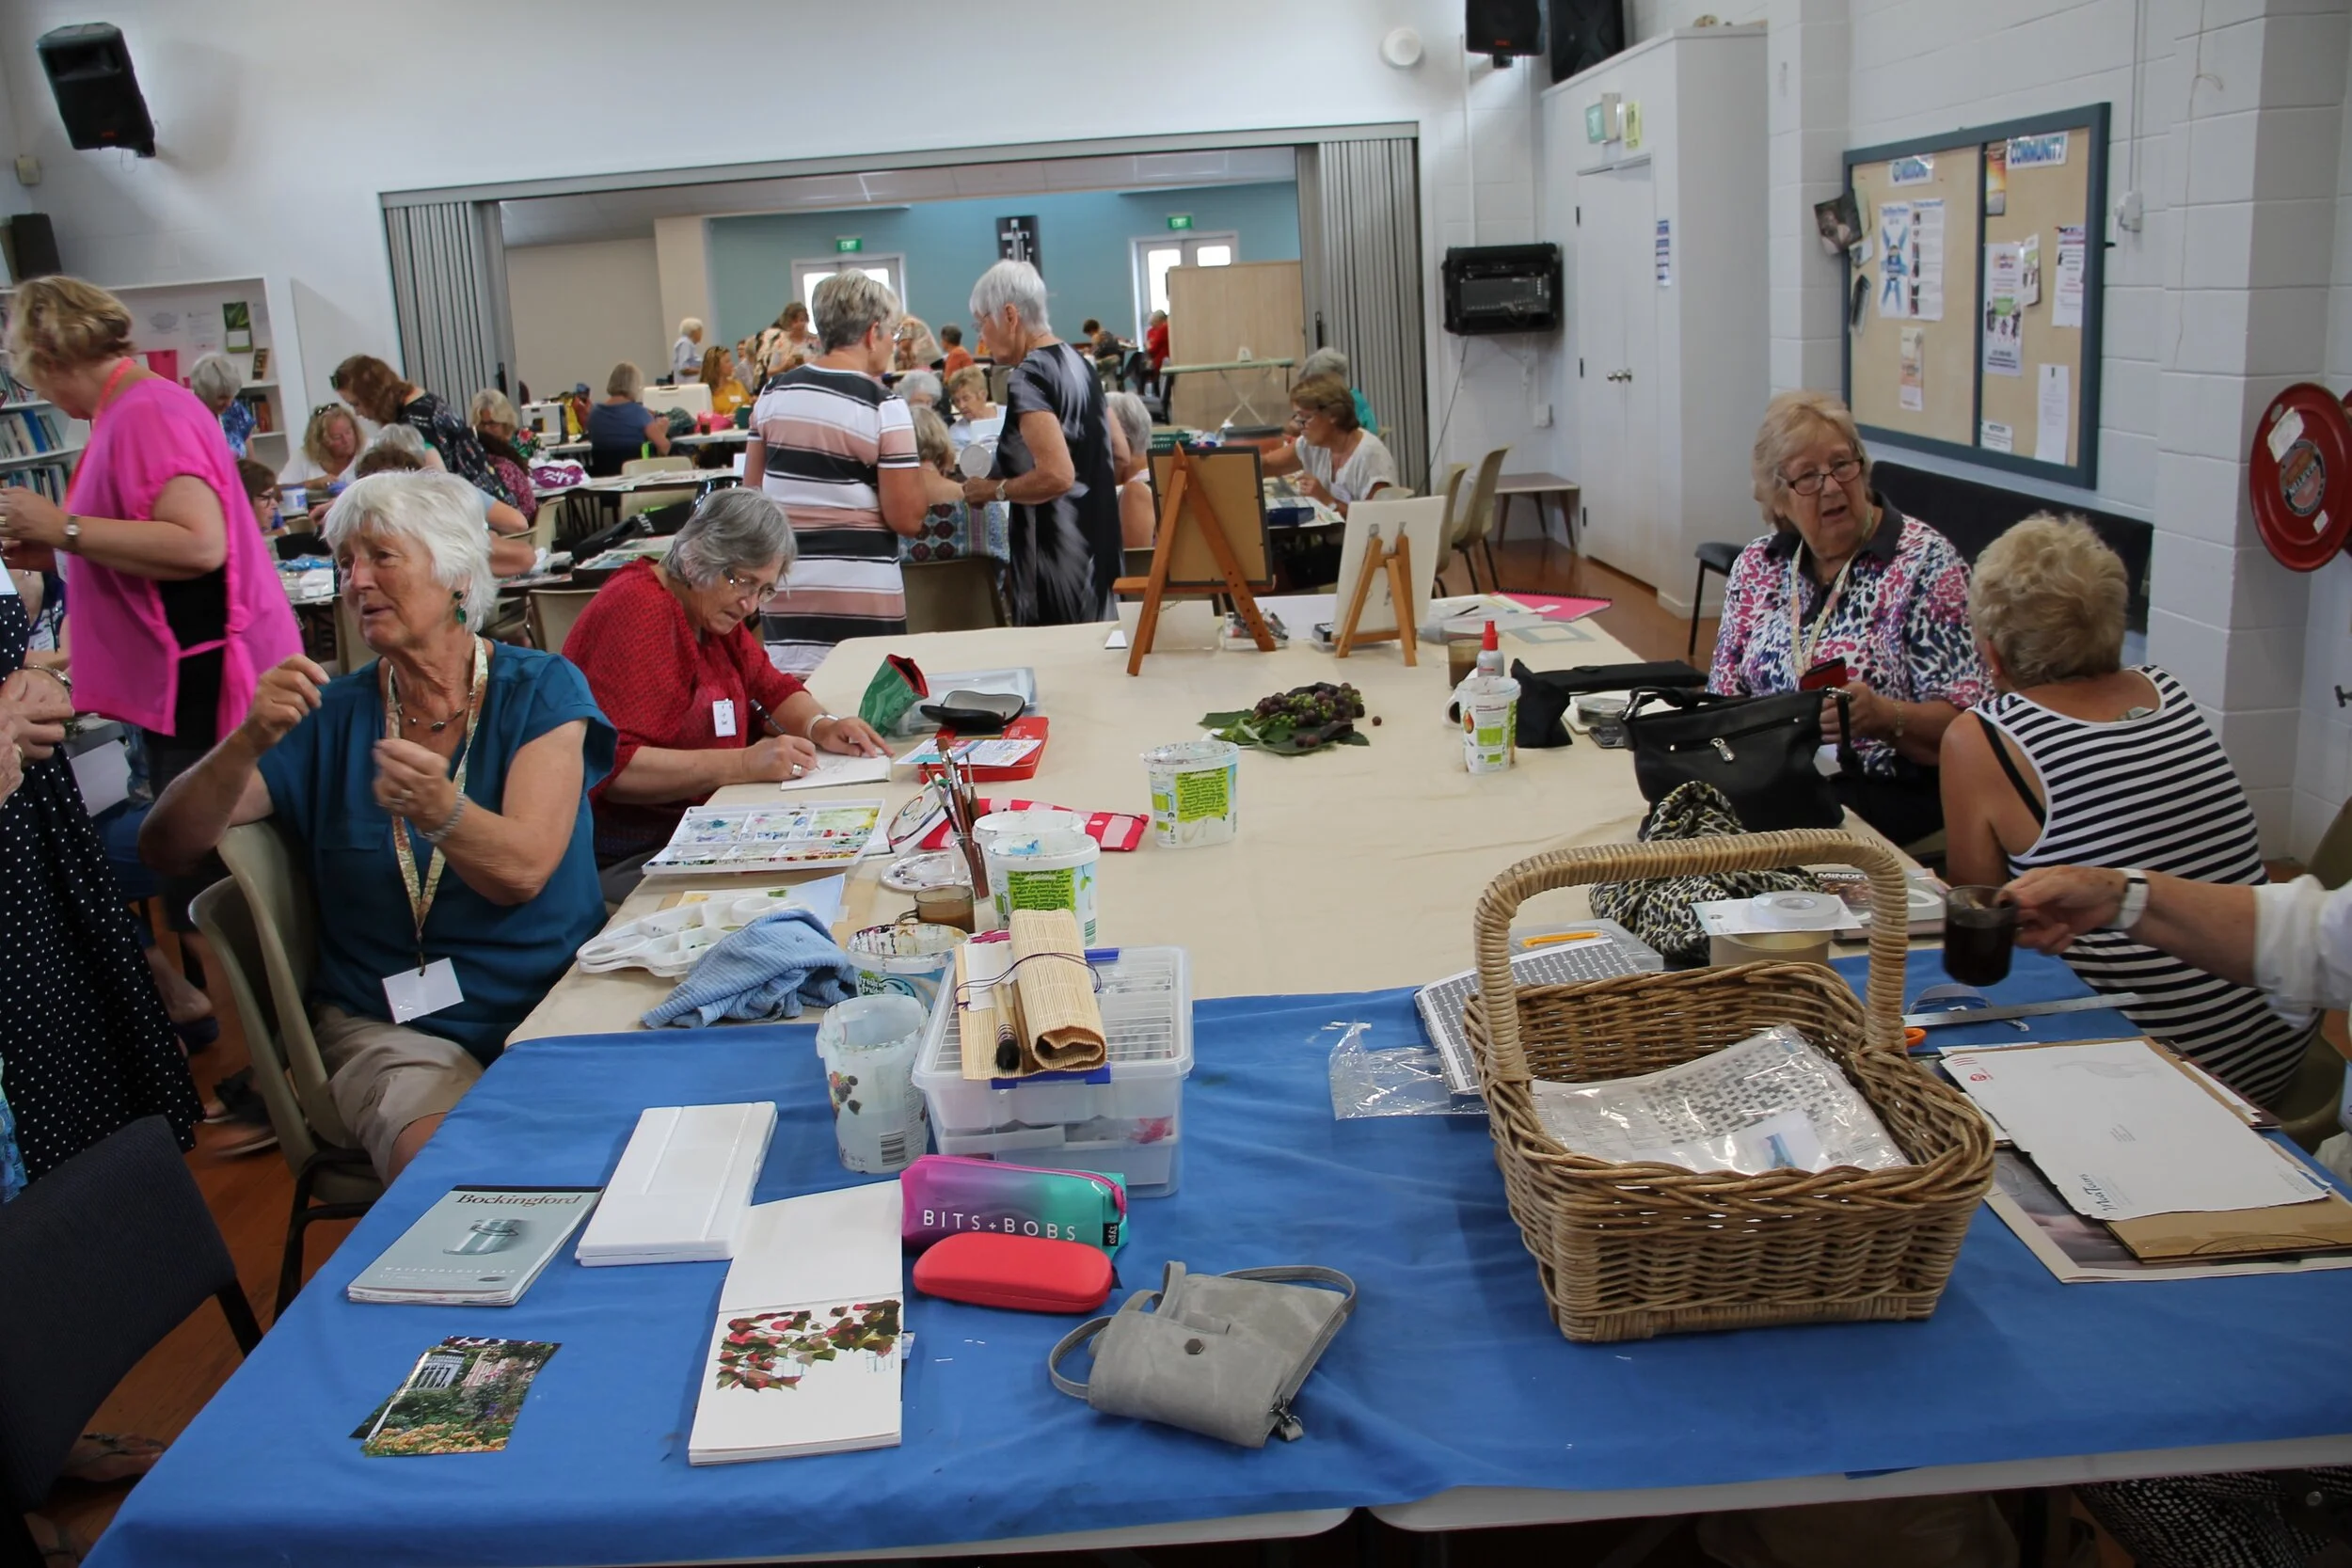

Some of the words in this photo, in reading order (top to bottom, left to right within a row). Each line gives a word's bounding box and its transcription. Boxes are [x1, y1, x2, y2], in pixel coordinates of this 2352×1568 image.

[2010, 135, 2065, 165] COMMUNITY
[456, 1194, 582, 1208] Bockingford
[923, 1210, 1076, 1242] BITS+BOBS
[1108, 1226, 1118, 1244] Typo
